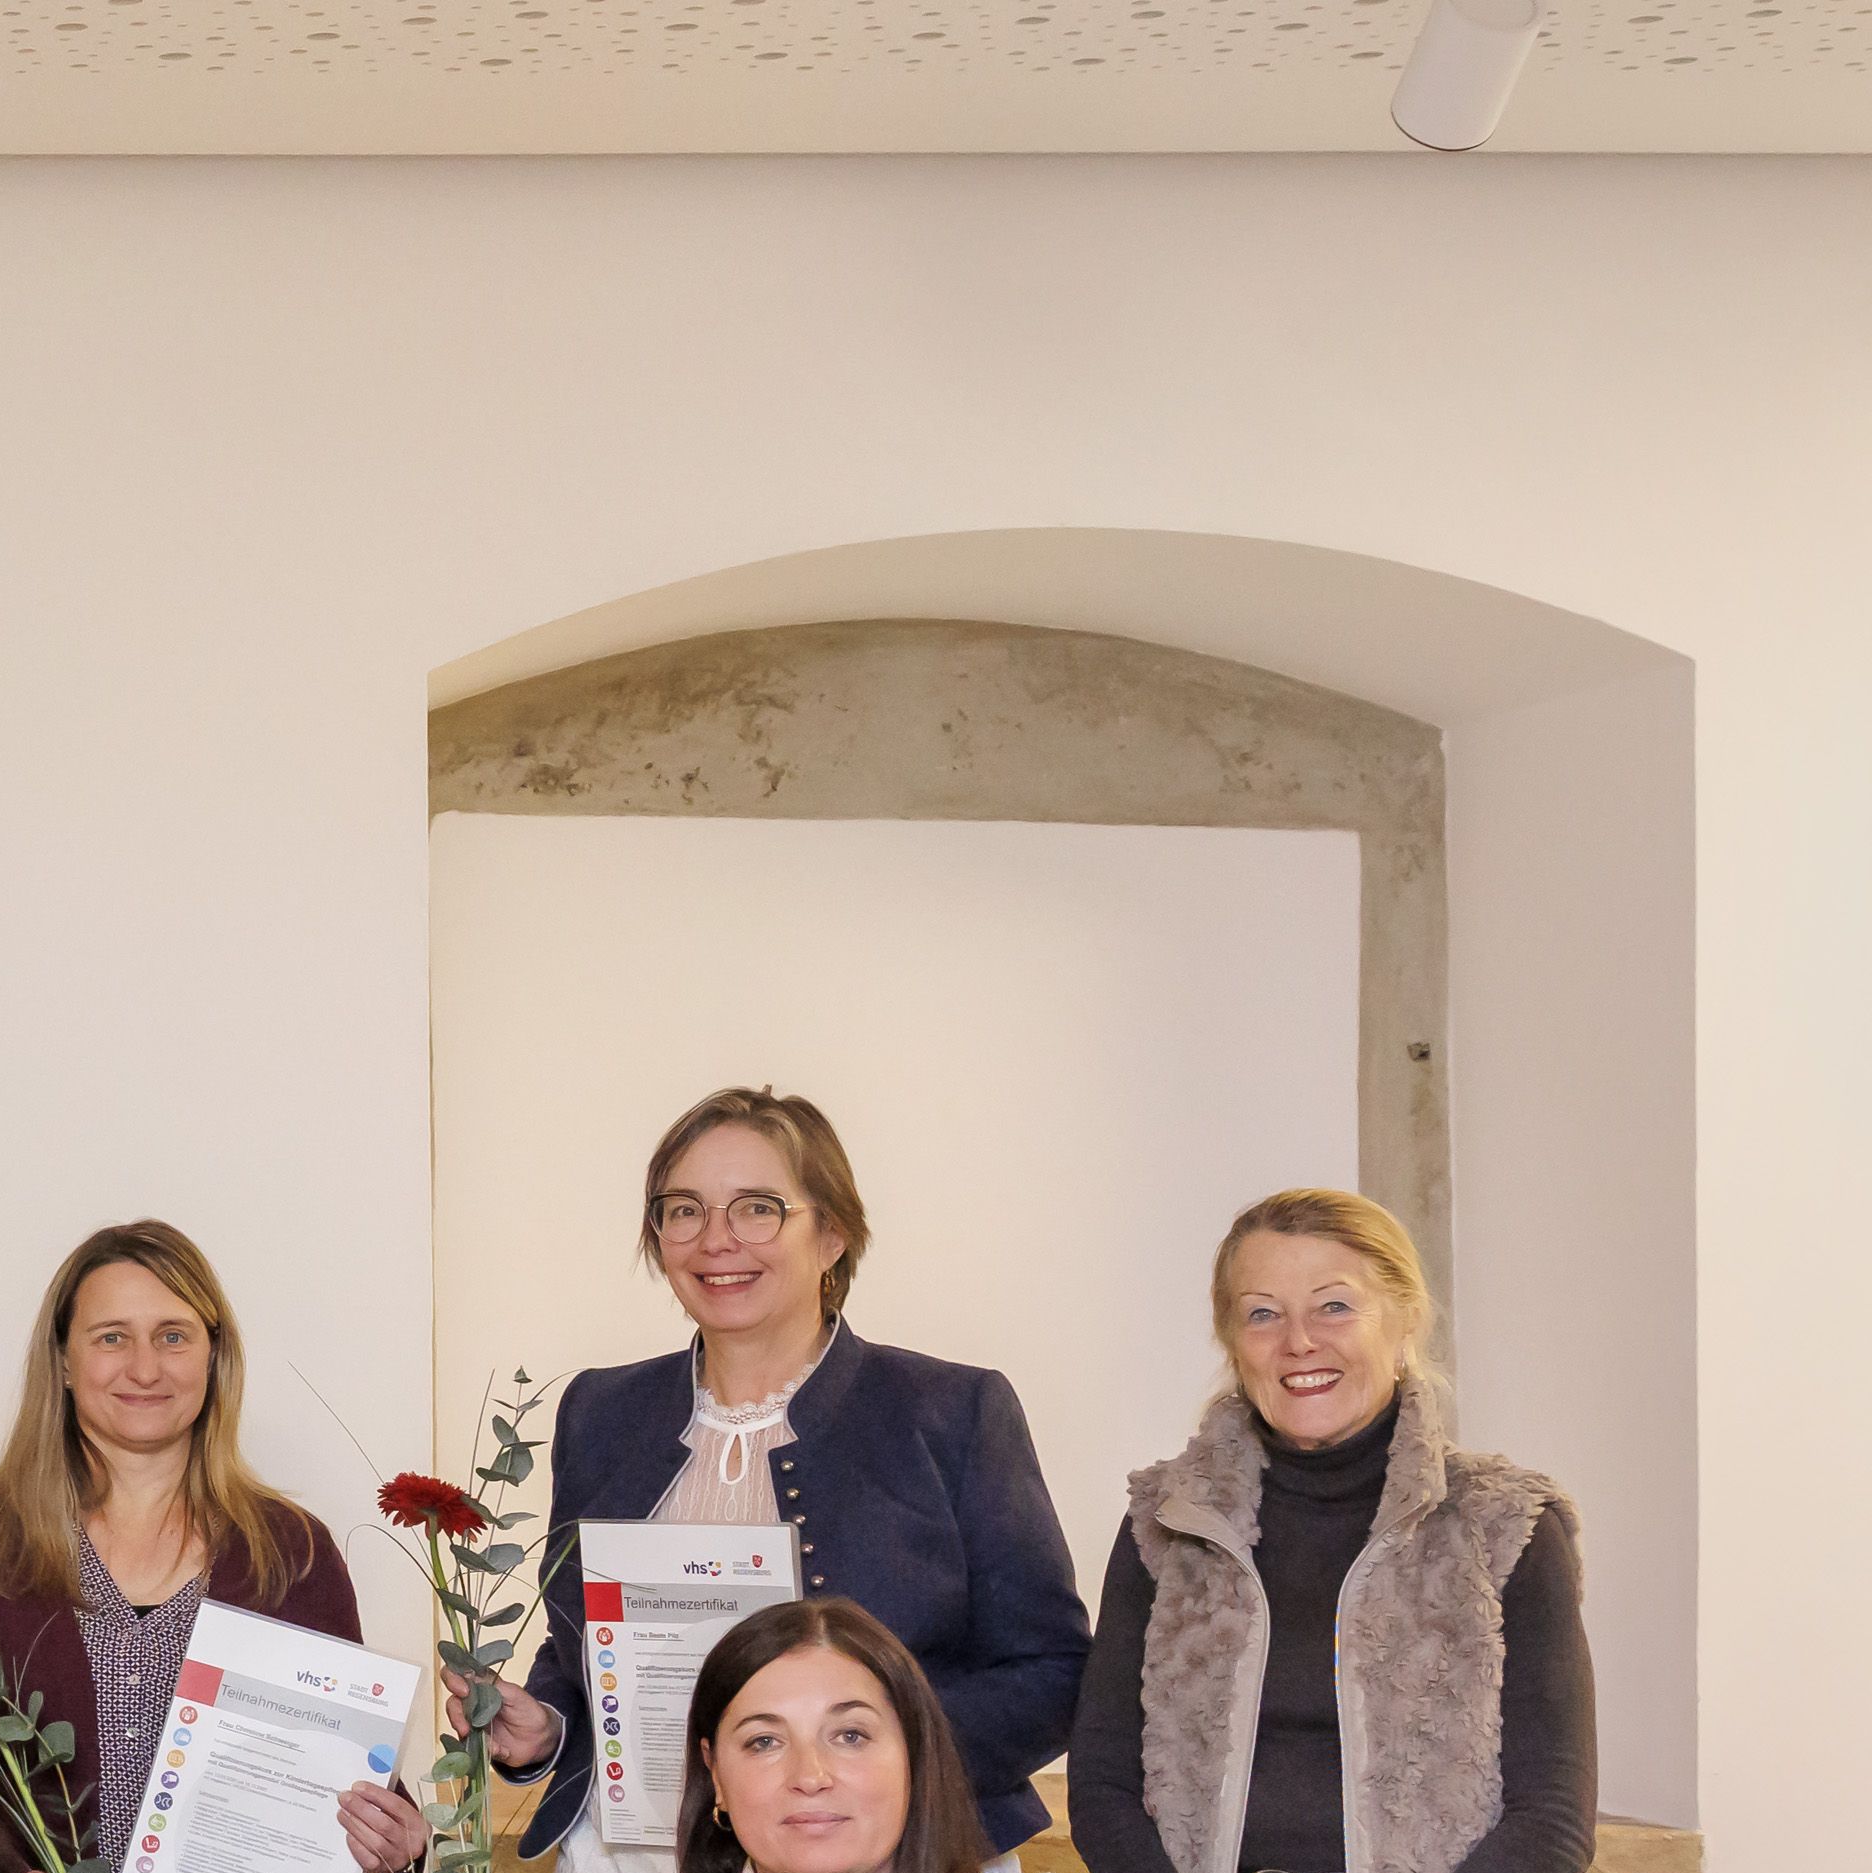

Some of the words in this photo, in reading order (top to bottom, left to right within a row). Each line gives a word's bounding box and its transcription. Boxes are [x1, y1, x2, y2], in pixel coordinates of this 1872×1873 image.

[683, 1561, 707, 1575] vhs
[624, 1596, 739, 1612] Teilnahmezertifikat
[296, 1669, 322, 1688] vhs
[221, 1684, 342, 1730] Teilnahmezertifikat
